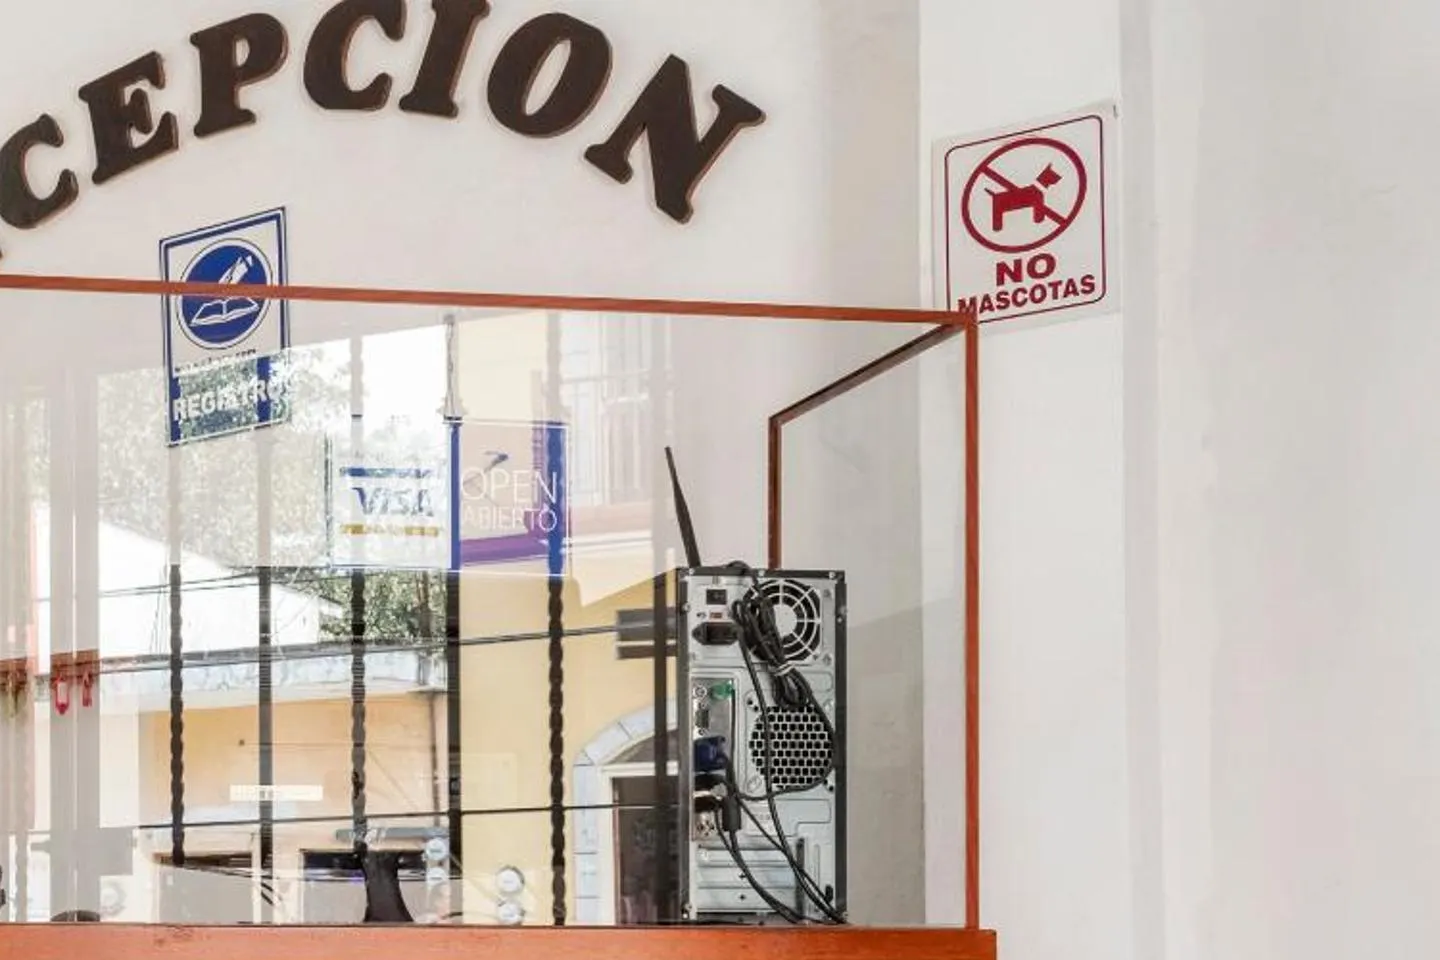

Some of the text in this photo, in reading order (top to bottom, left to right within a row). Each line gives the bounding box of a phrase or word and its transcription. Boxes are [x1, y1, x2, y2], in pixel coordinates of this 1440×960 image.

[996, 253, 1057, 286] NO
[957, 274, 1096, 314] MASCOTAS
[351, 487, 435, 517] VISA
[462, 466, 558, 506] OPEN
[463, 503, 558, 532] ABIERTO
